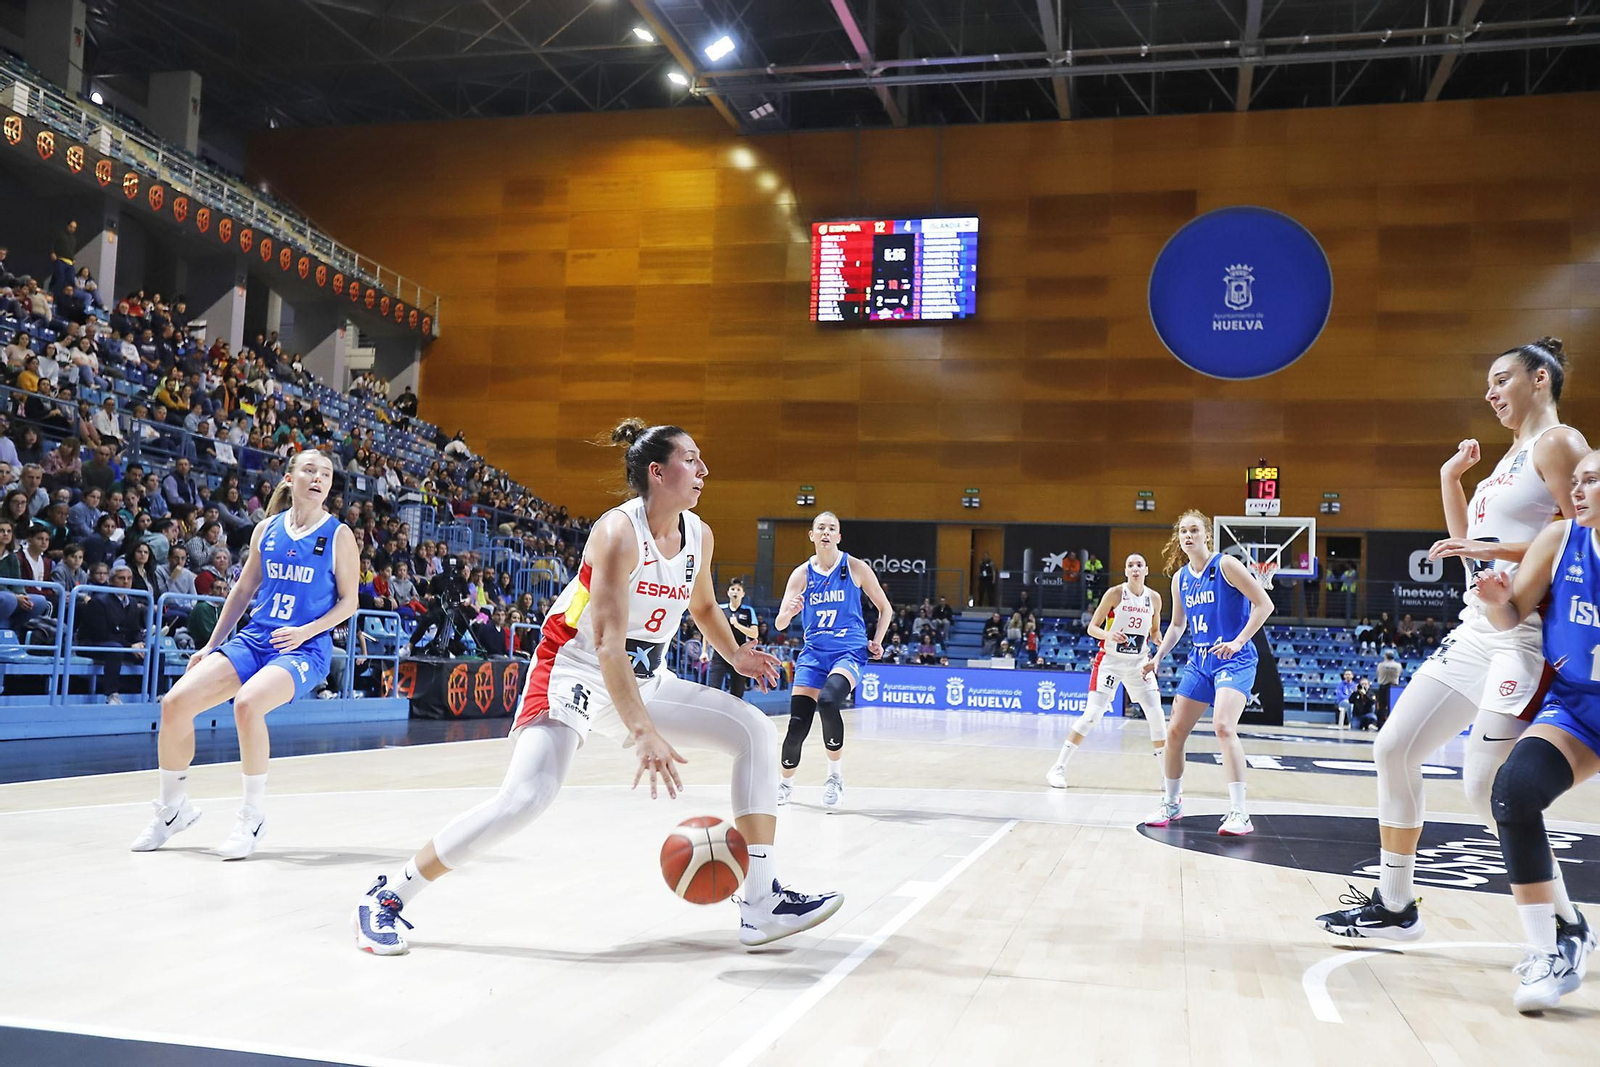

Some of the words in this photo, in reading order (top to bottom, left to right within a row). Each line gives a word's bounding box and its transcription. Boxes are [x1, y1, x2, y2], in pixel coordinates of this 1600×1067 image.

[874, 221, 886, 232] 12
[903, 220, 911, 232] 4
[876, 295, 884, 307] 2
[1213, 312, 1255, 320] Ayuntamiento
[1212, 320, 1264, 331] HUELVA
[1255, 467, 1278, 480] 5:55
[1258, 480, 1276, 499] 19
[1249, 501, 1278, 510] renfe
[1474, 496, 1487, 526] 14
[266, 558, 315, 584] ÍSLAND
[1565, 575, 1584, 584] errea
[809, 589, 845, 605] ÍSLAND
[269, 592, 296, 620] 13
[1121, 605, 1150, 614] ESPAÑA
[1569, 595, 1600, 628] ÍSL
[644, 608, 667, 633] 8
[815, 609, 837, 628] 27
[1127, 616, 1143, 629] 33
[1192, 613, 1208, 635] 14
[883, 683, 925, 693] Ayuntamiento
[926, 685, 936, 693] de
[968, 687, 1011, 696] Ayuntamiento
[882, 691, 936, 705] HUELVA
[967, 695, 1022, 709] HUELVA
